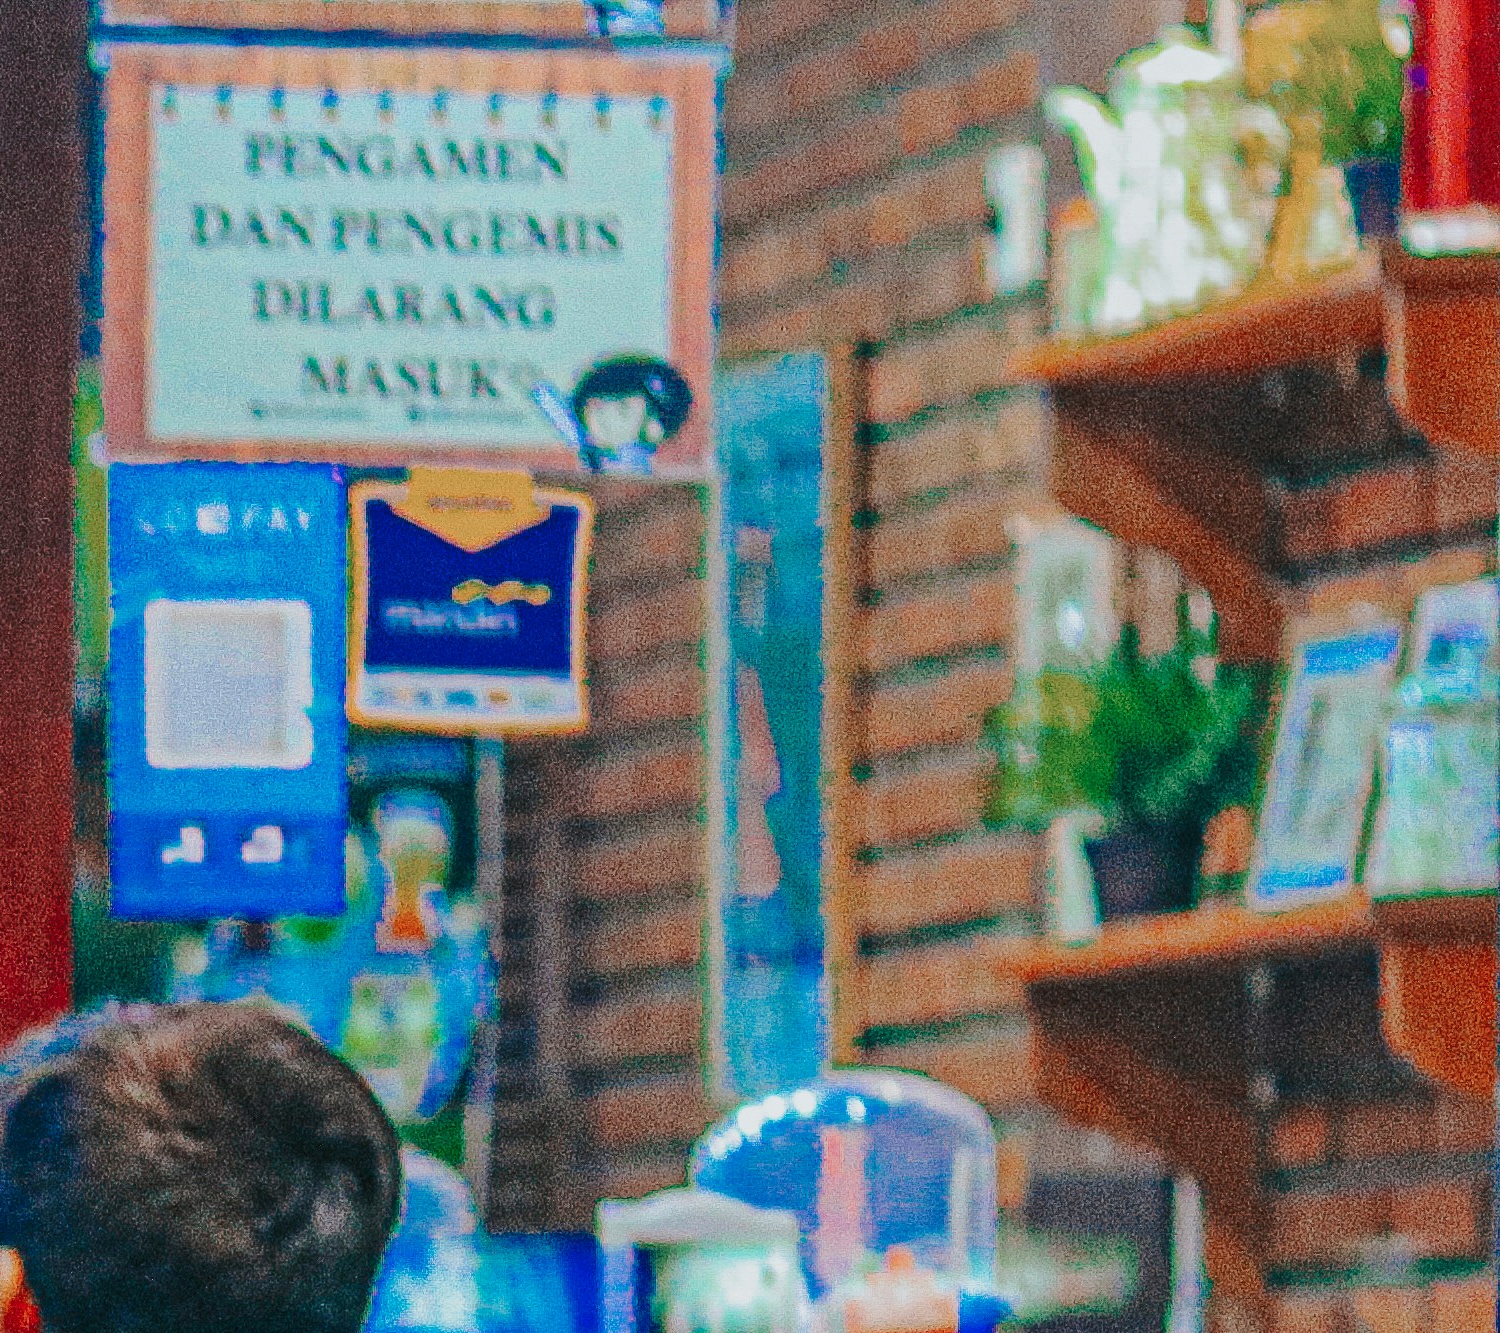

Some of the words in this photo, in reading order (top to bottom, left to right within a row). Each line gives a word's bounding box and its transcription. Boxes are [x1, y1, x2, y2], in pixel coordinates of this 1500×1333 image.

[246, 132, 568, 182] PENGAMEN
[191, 203, 312, 249] DAN
[331, 207, 622, 256] PENGEMIS
[253, 279, 556, 331] DILARANG
[303, 355, 499, 399] MASUK
